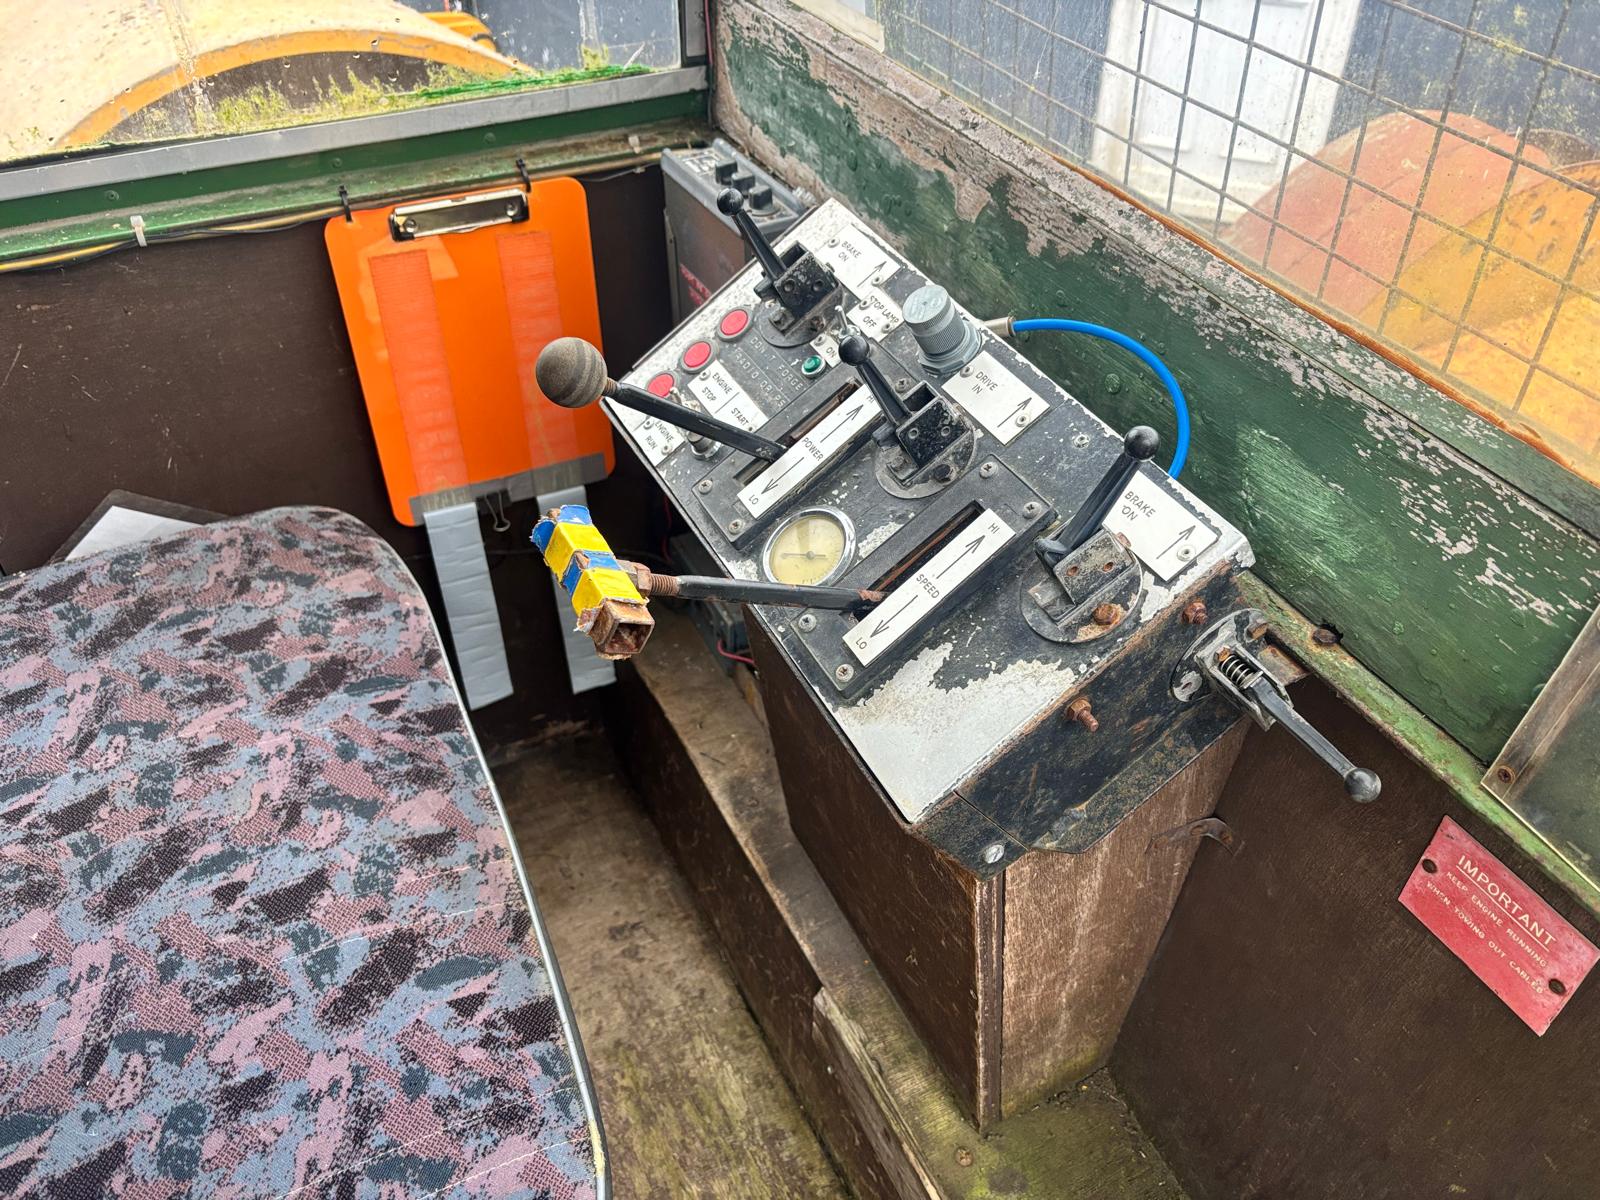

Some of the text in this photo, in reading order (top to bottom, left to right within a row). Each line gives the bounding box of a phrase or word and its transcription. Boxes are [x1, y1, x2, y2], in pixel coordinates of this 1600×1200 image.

[838, 251, 849, 262] ON
[841, 240, 862, 258] BRAKE
[870, 295, 900, 323] STOP LAMP
[863, 316, 877, 327] OFF
[826, 346, 837, 358] ON
[712, 372, 734, 395] ENGINE
[971, 384, 983, 395] IN
[975, 371, 998, 391] DRIVE
[701, 386, 717, 402] STOP
[731, 407, 749, 426] START
[654, 420, 674, 443] ENGINE
[645, 435, 658, 450] RUN
[801, 437, 824, 462] POWER
[748, 494, 759, 505] LO
[1124, 491, 1156, 518] BRAKE
[1121, 504, 1138, 521] ON
[987, 522, 1001, 535] HI
[916, 573, 940, 599] SPEED
[855, 636, 868, 650] LO
[1458, 855, 1557, 945] IMPORTANT
[1446, 871, 1547, 967] KEEP ENGINE RUNNING
[1427, 880, 1543, 993] WHEN TOWING OUT CABLES
